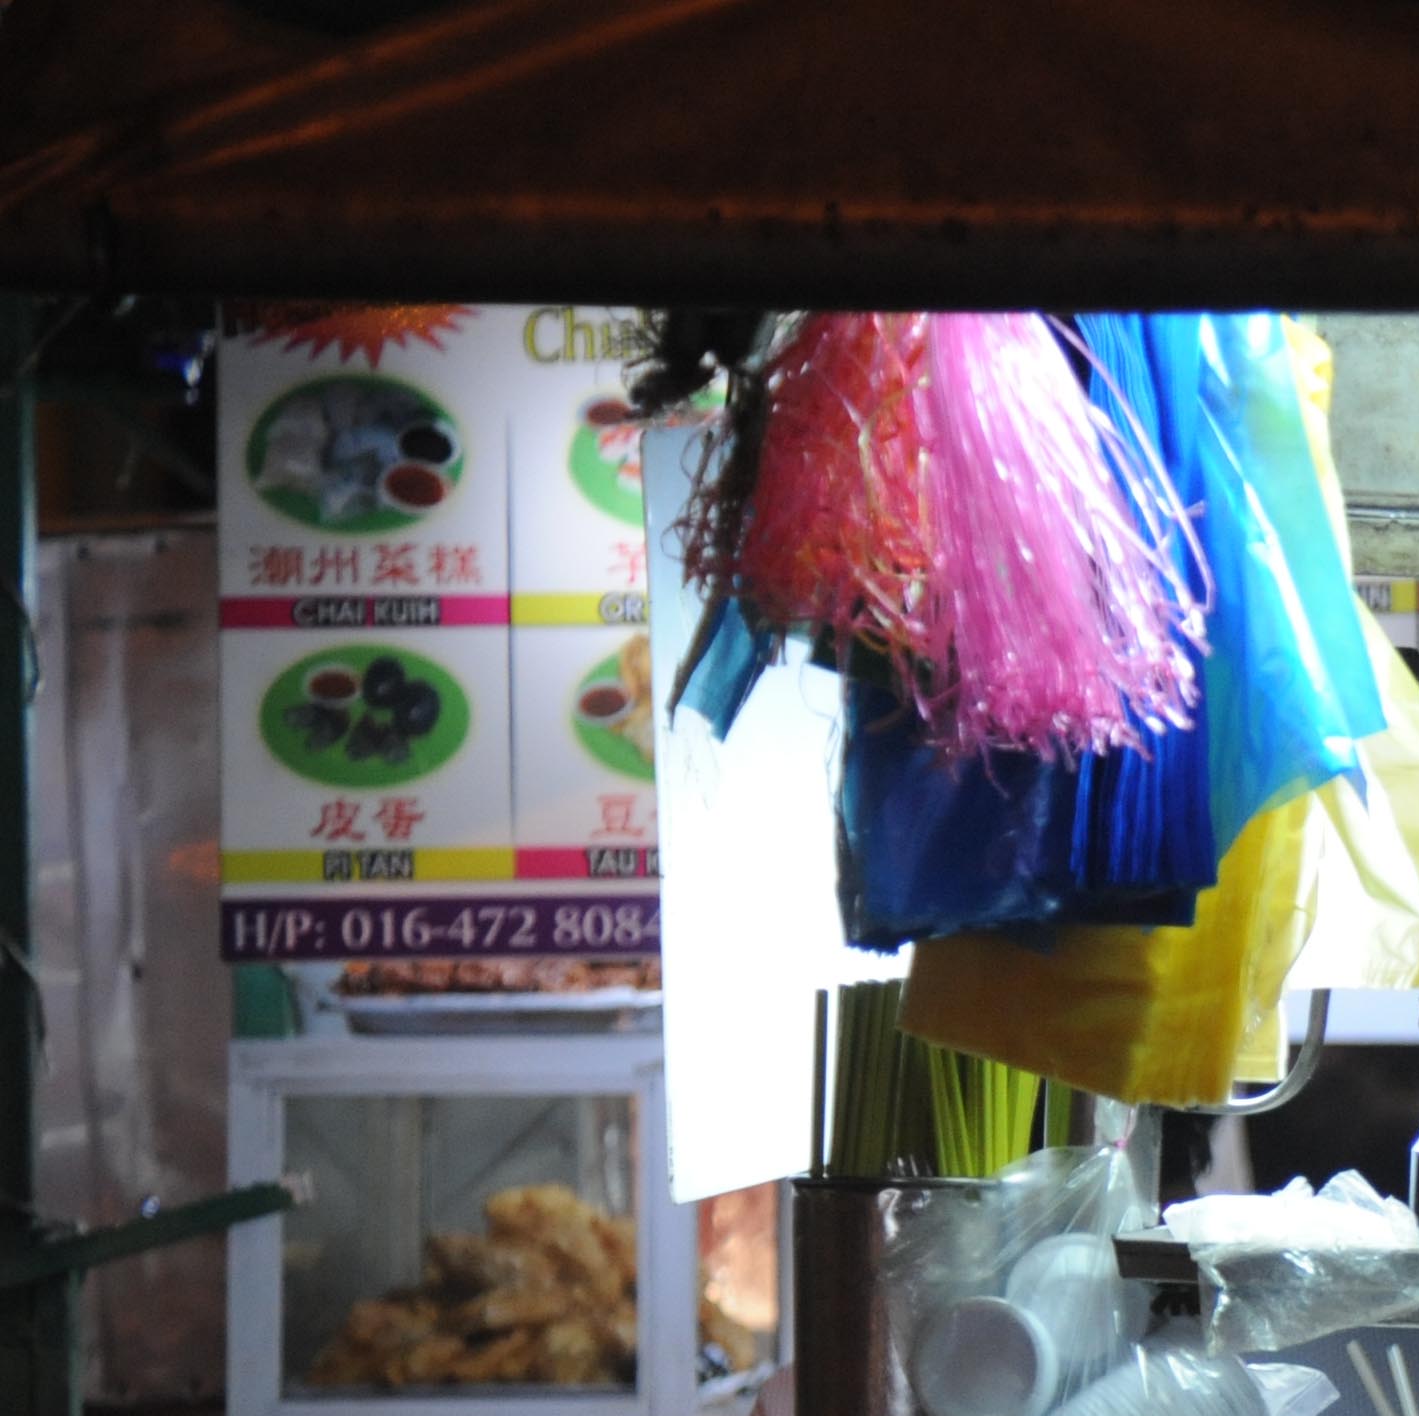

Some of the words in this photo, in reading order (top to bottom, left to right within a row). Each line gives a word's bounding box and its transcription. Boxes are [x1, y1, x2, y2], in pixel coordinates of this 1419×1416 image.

[293, 596, 367, 627] CHAI
[373, 596, 440, 627] KUIH
[310, 797, 426, 841] 皮蛋
[590, 794, 657, 838] 豆
[323, 848, 352, 880] PI
[356, 848, 414, 880] TAN
[587, 848, 638, 878] TAU
[233, 906, 327, 953] H/P:
[340, 906, 538, 950] 016-472
